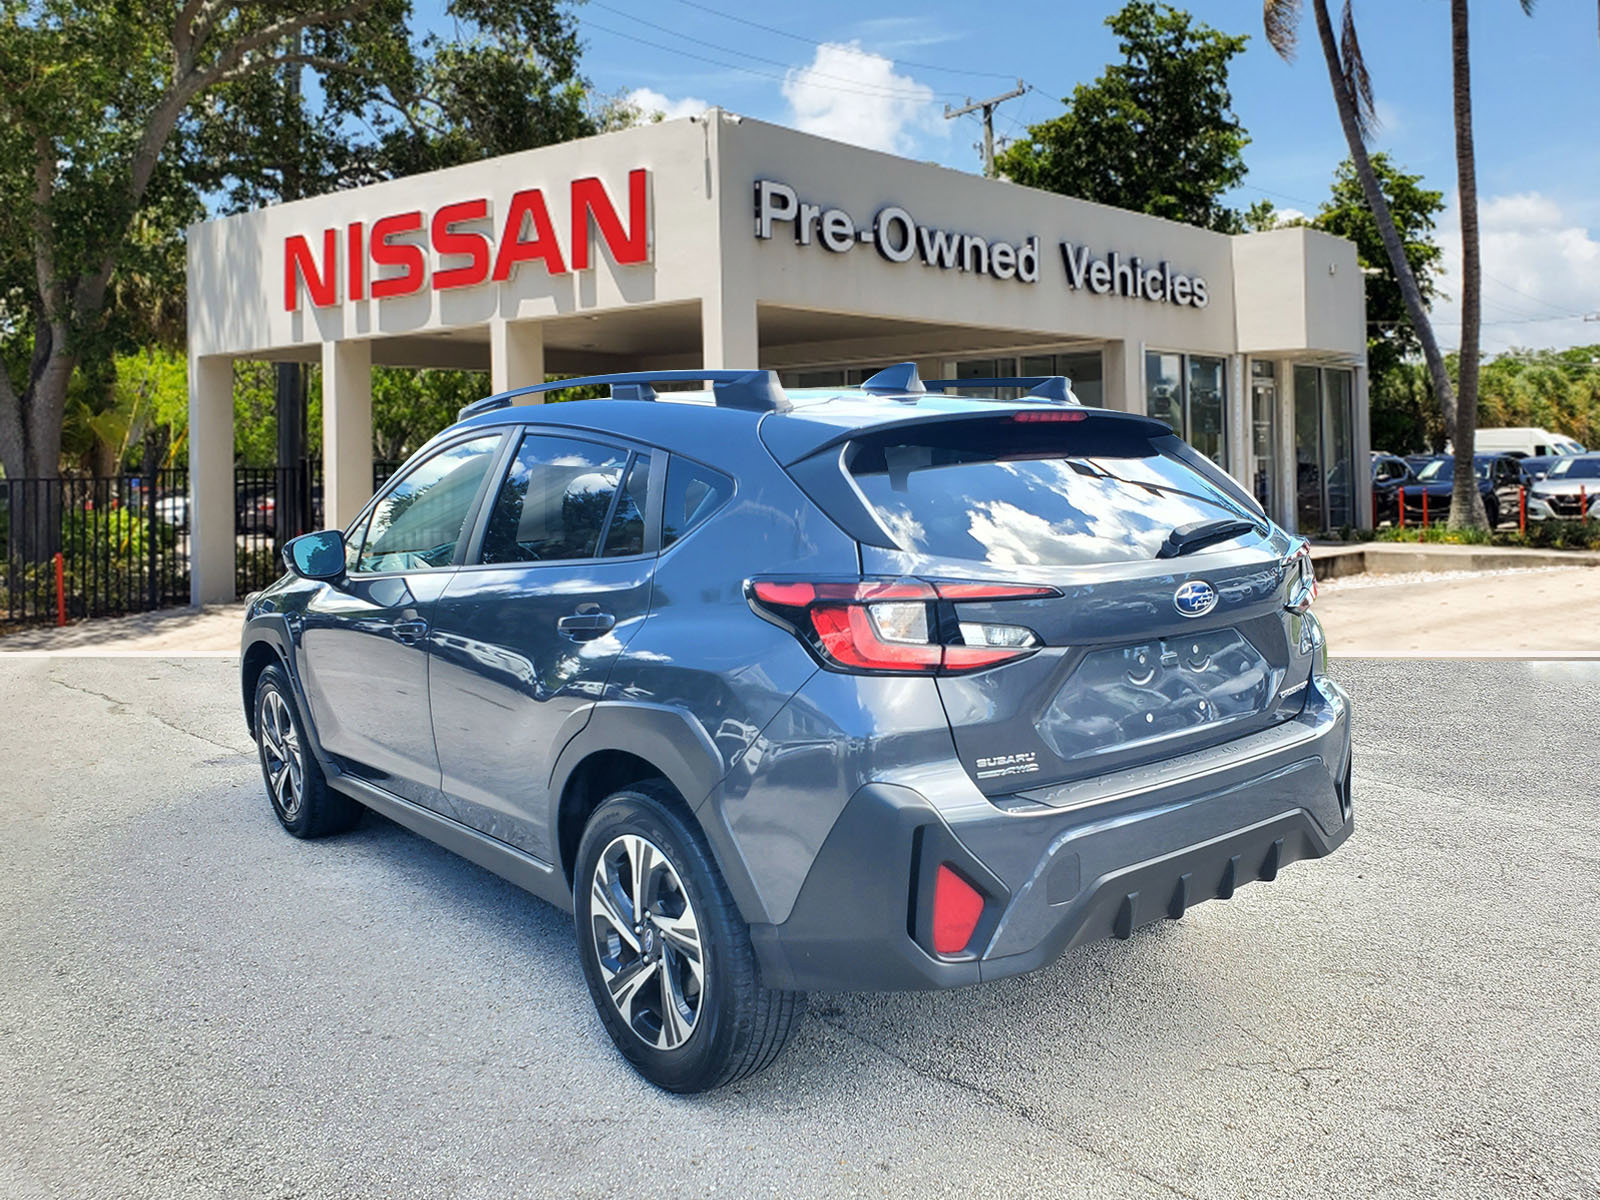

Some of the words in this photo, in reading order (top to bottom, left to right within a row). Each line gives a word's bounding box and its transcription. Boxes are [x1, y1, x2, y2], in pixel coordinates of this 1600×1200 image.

[284, 168, 648, 312] NISSAN
[755, 180, 1040, 283] Pre-Owned
[1060, 241, 1209, 308] Vehicles
[976, 752, 1036, 768] SUBARU
